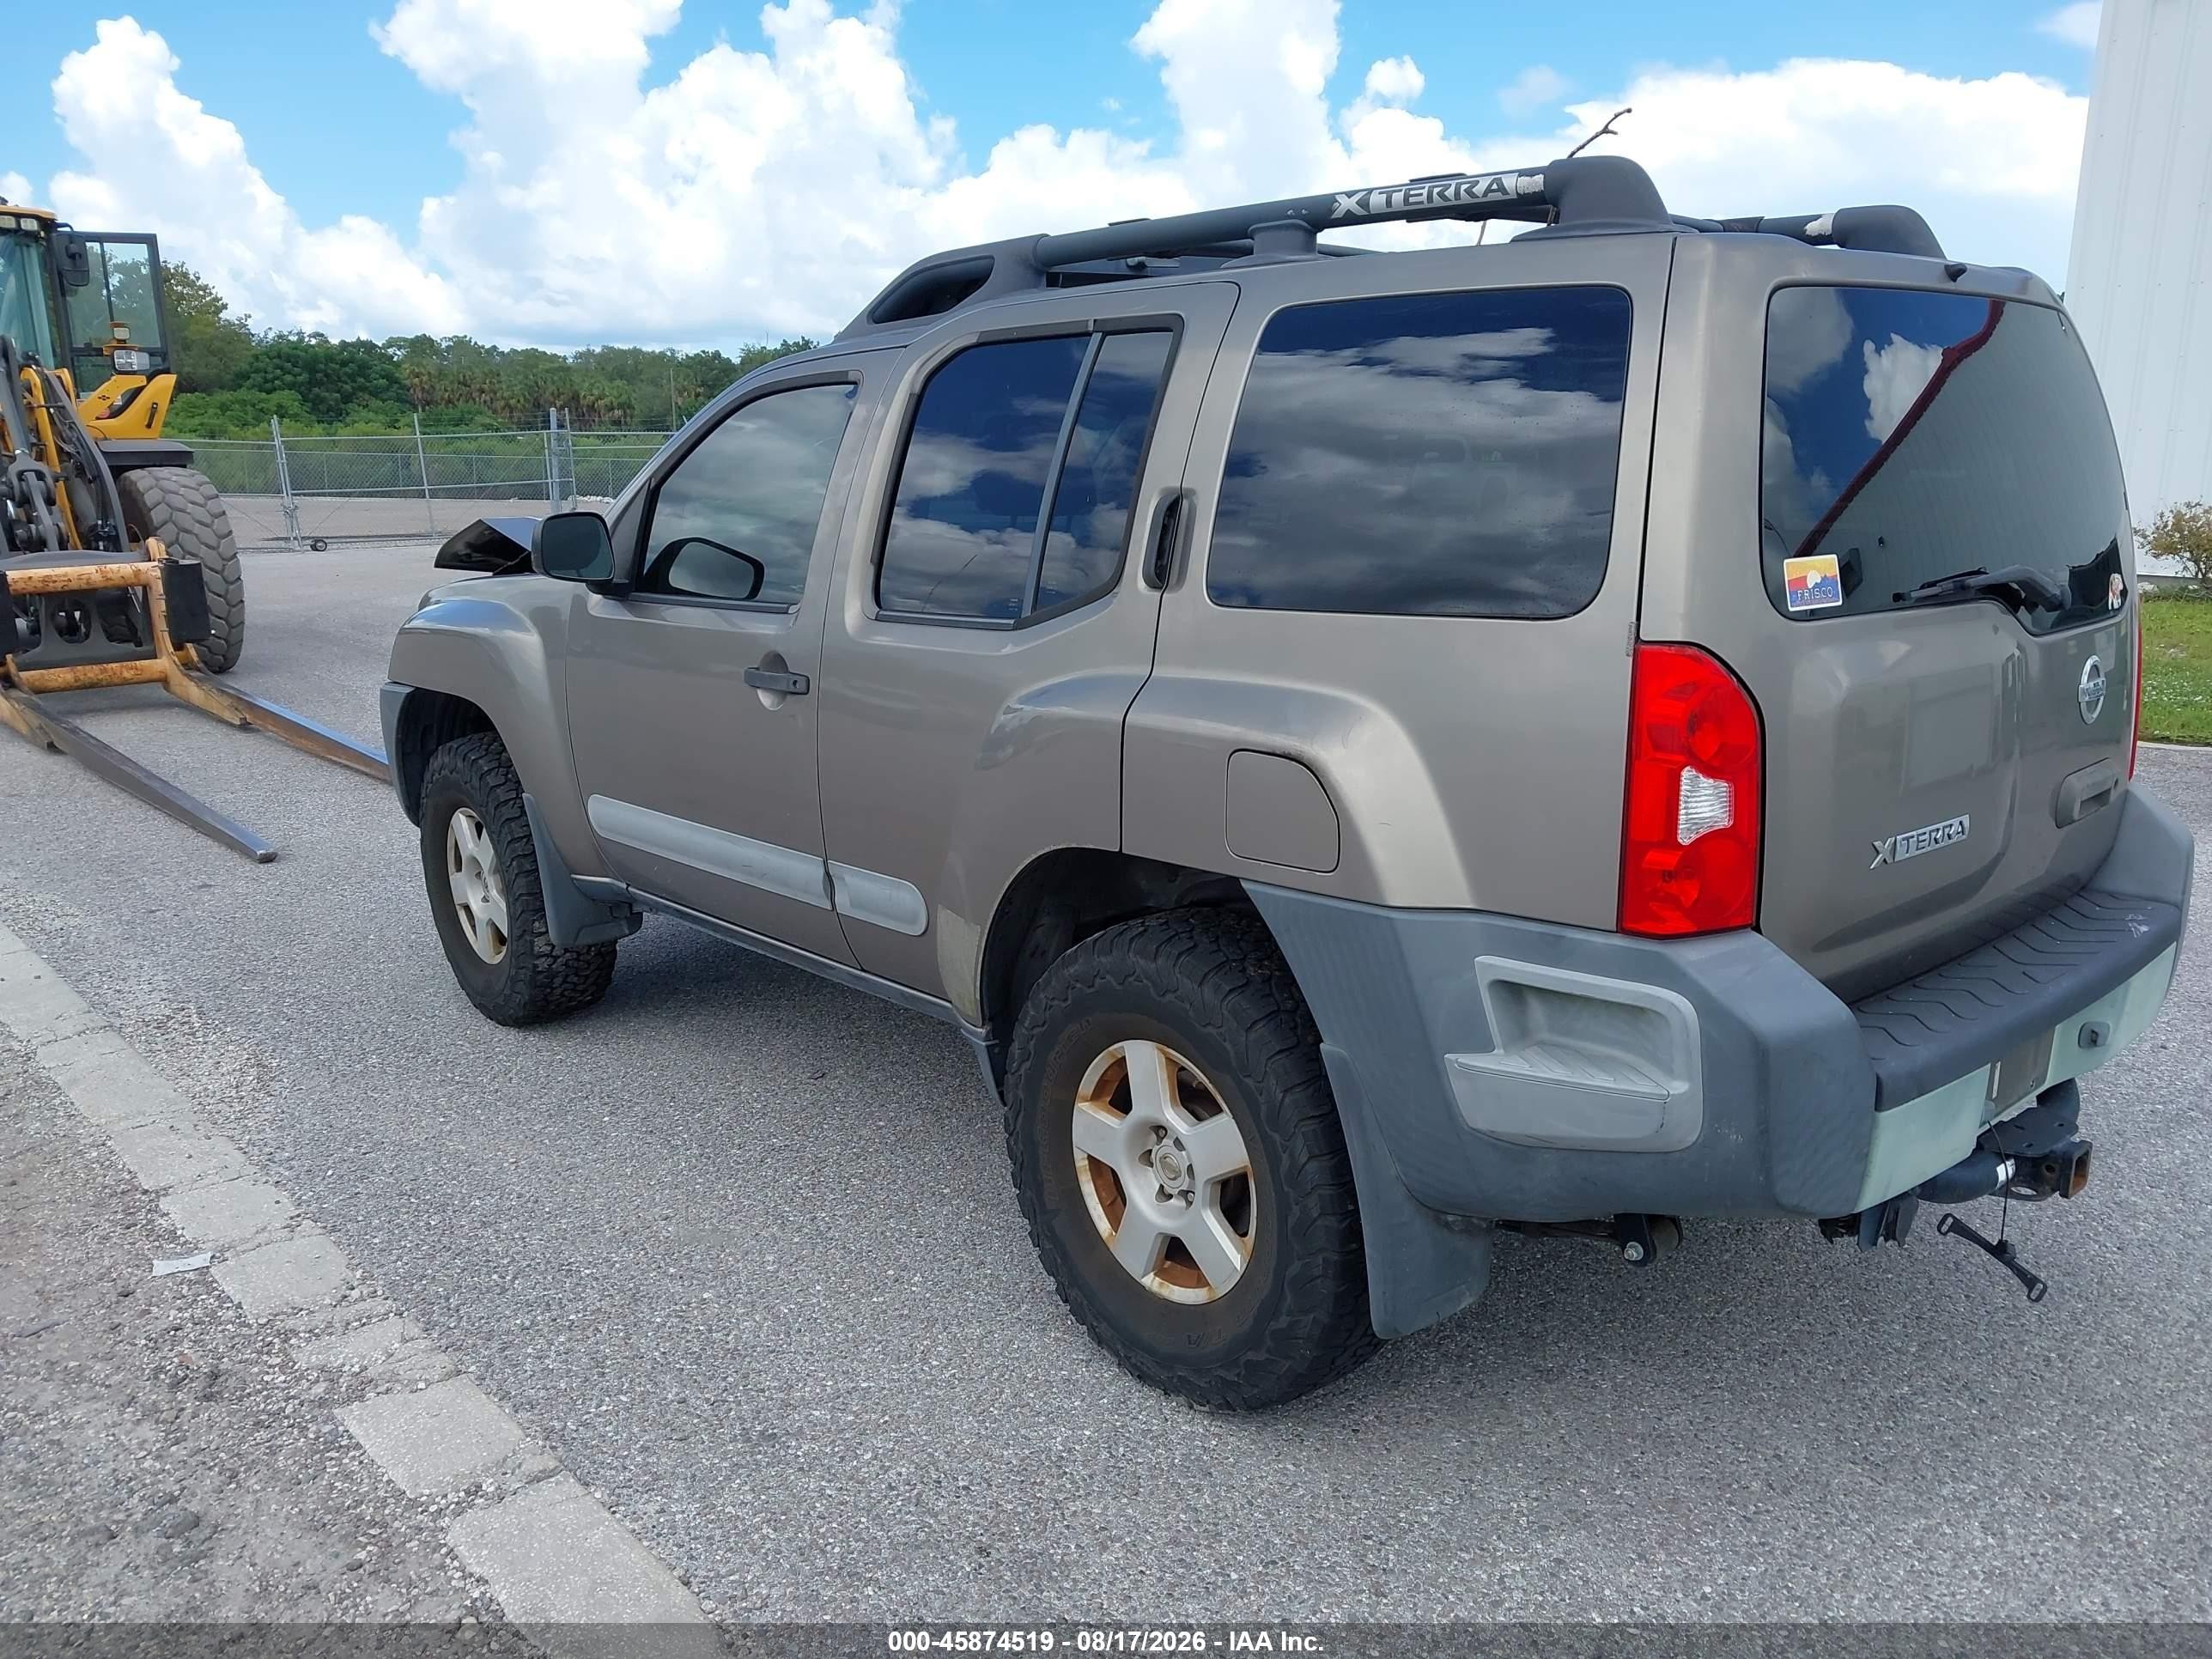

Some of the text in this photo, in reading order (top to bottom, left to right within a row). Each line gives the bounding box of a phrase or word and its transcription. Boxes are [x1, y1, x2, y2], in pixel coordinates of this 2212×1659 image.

[1331, 175, 1511, 219] XTERRA
[1797, 586, 1833, 601] FRISCO
[1869, 820, 1966, 870] XTERRA
